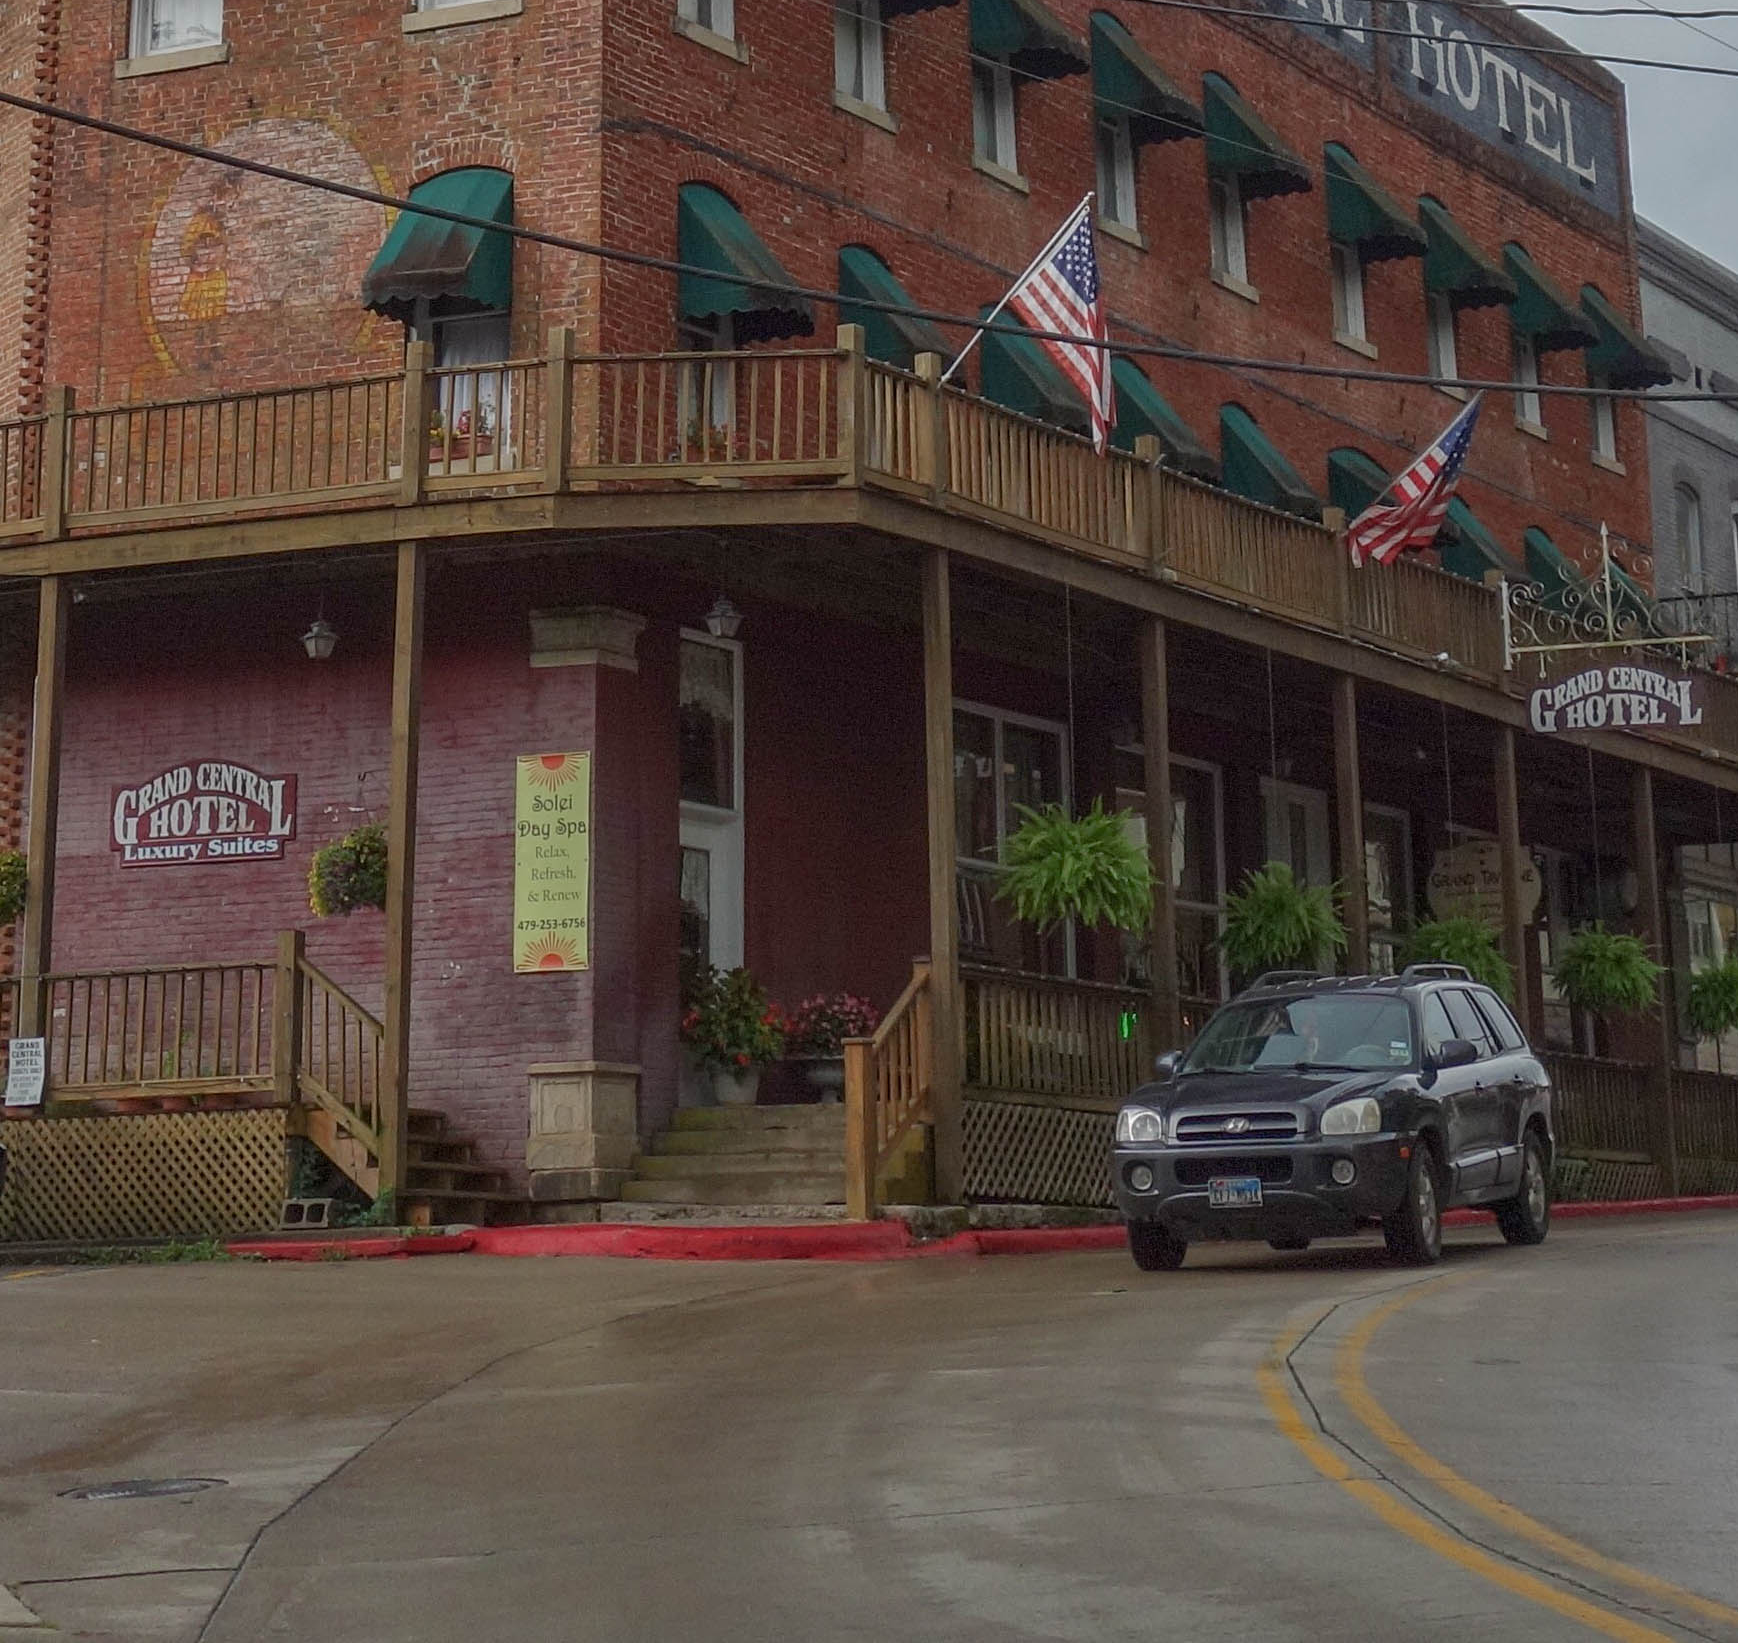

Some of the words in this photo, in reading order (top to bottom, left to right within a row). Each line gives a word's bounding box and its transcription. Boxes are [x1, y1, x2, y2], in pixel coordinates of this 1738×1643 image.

[1406, 2, 1597, 184] HOTEL
[1530, 670, 1603, 733] GRAND
[1608, 667, 1702, 725] CENTRAL
[1566, 693, 1666, 728] HOTEL
[114, 766, 192, 845] GRAND
[197, 763, 291, 836] CENTRAL
[149, 796, 254, 838] HOTEL
[517, 820, 550, 839] Day
[555, 817, 587, 838] Spa
[124, 842, 202, 860] Luxury
[208, 837, 279, 855] Suites
[542, 889, 582, 902] Renew
